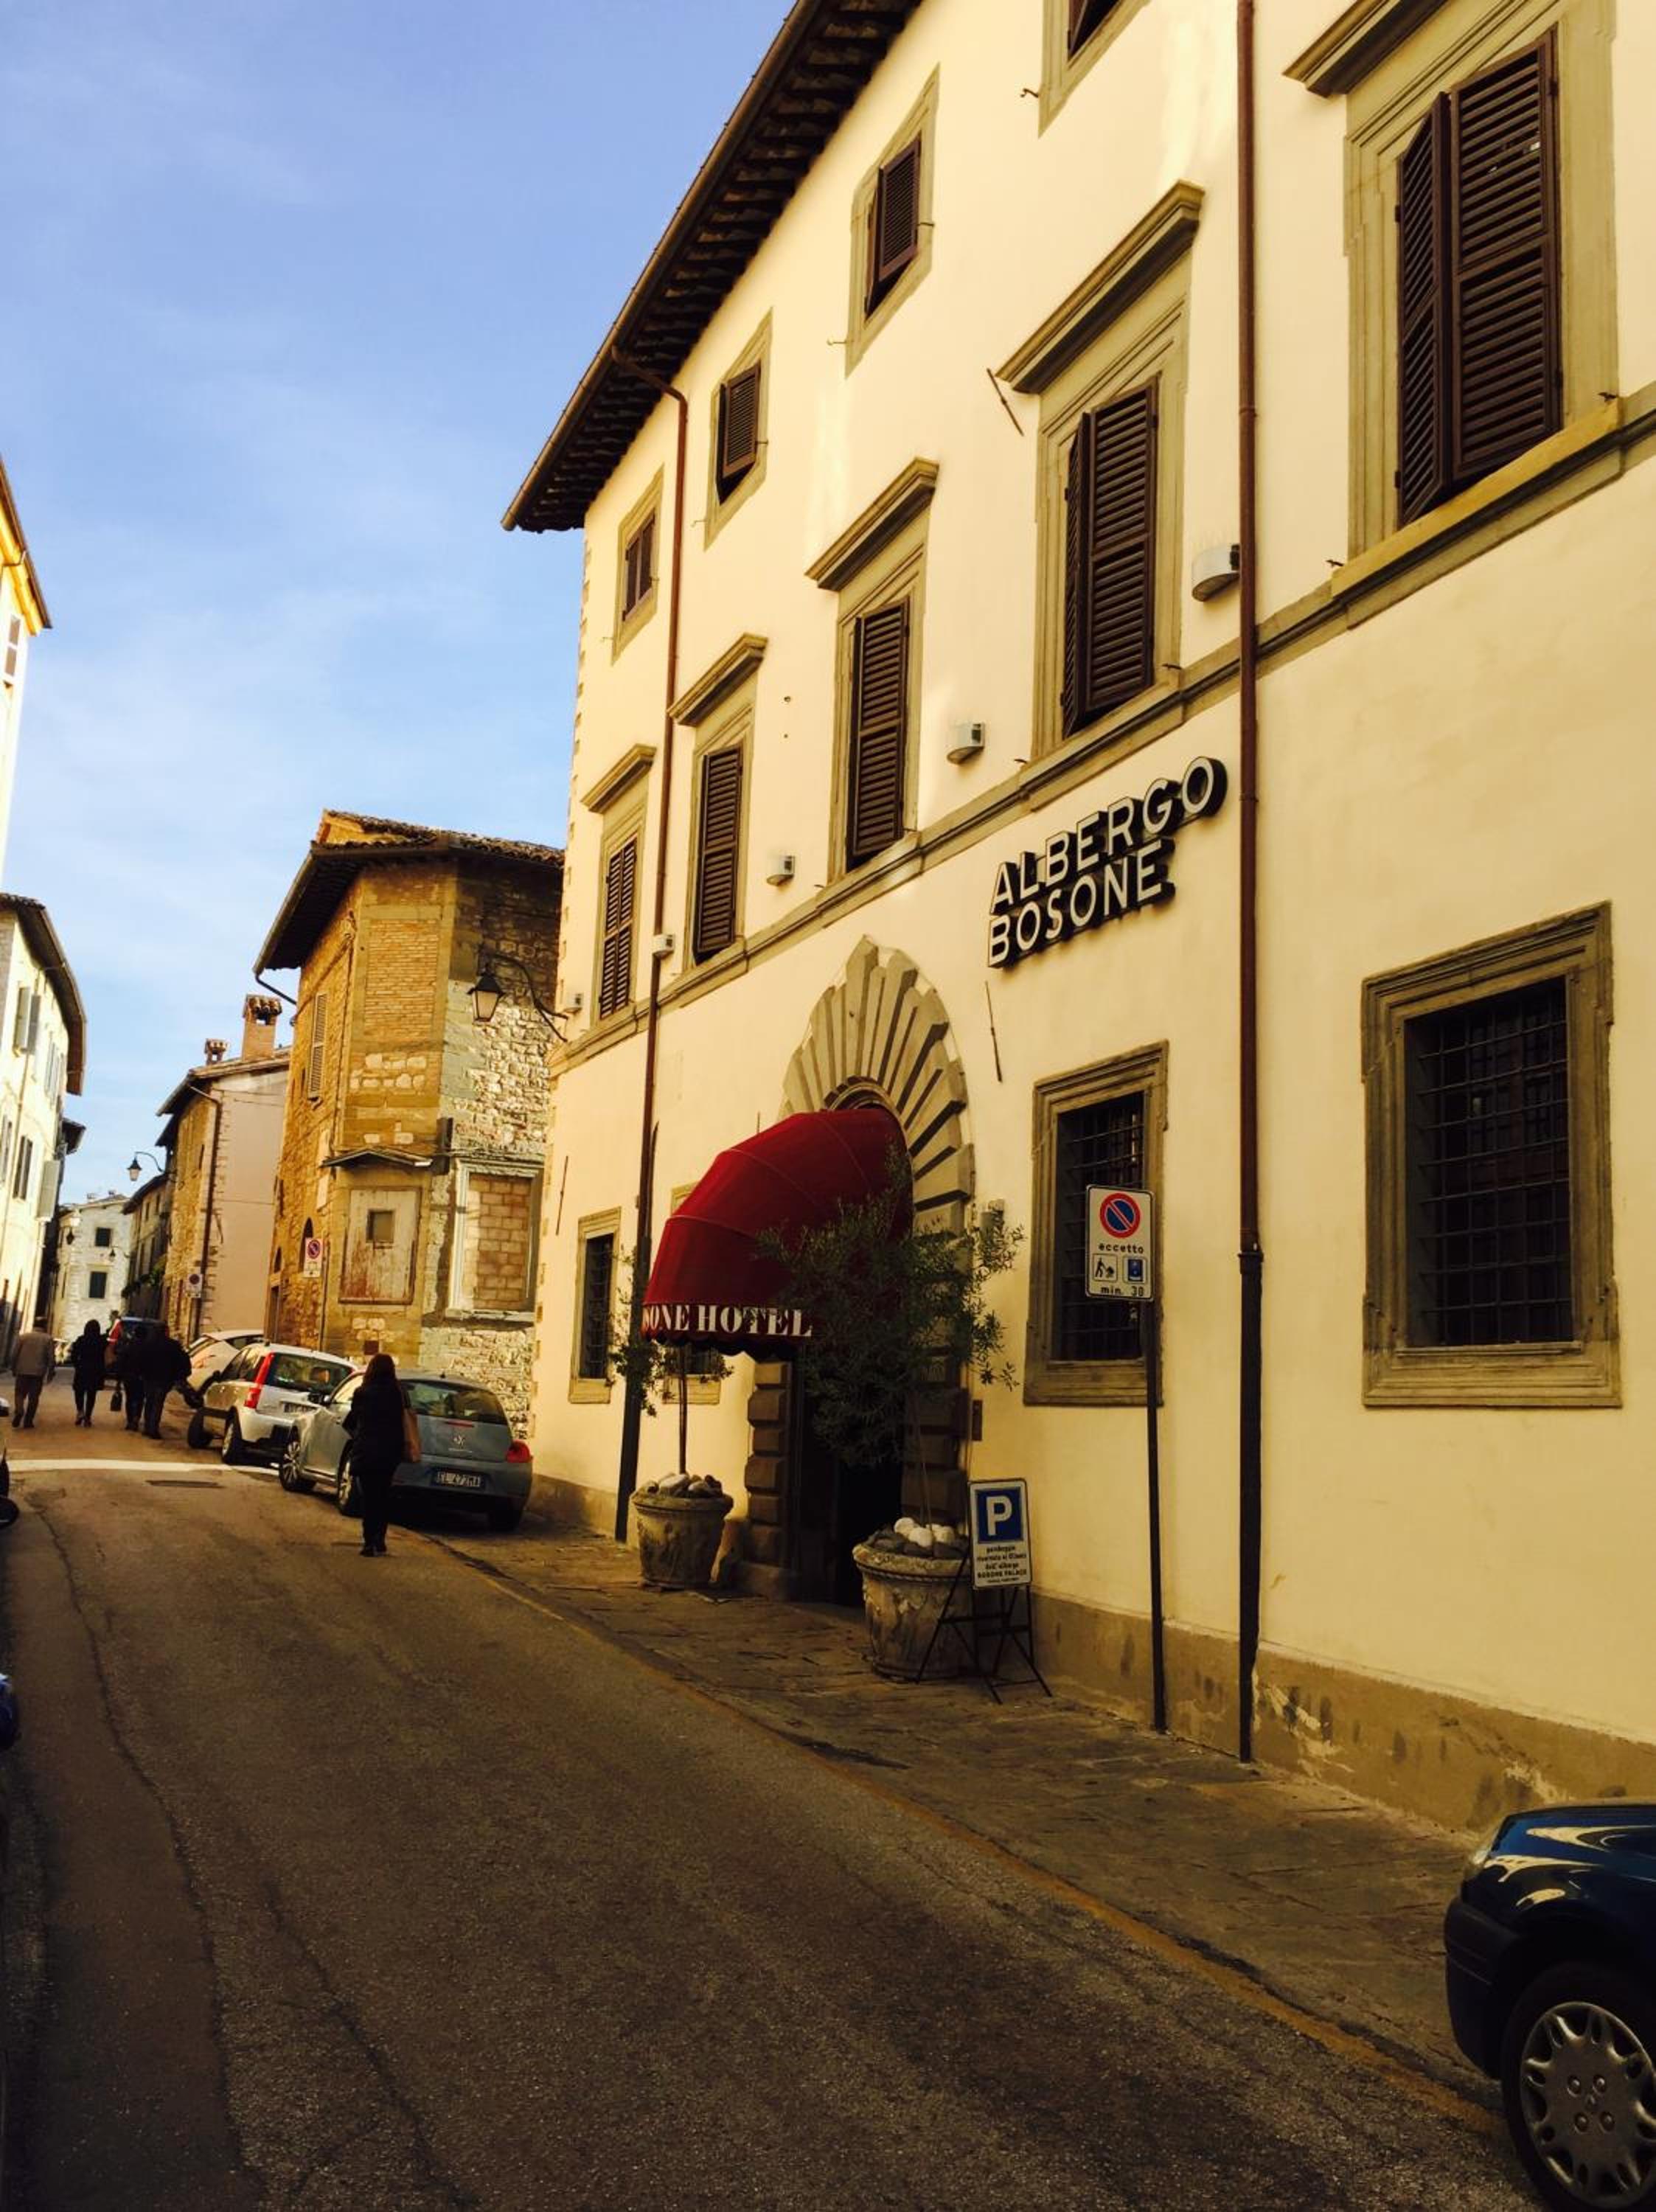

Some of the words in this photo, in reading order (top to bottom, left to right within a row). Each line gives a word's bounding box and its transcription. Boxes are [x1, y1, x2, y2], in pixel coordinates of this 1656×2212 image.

[989, 756, 1228, 914] ALBERGO
[987, 835, 1175, 969] BOSONE
[1099, 1243, 1144, 1253] eccetto
[697, 1304, 813, 1337] HOTEL
[986, 1496, 1012, 1536] P
